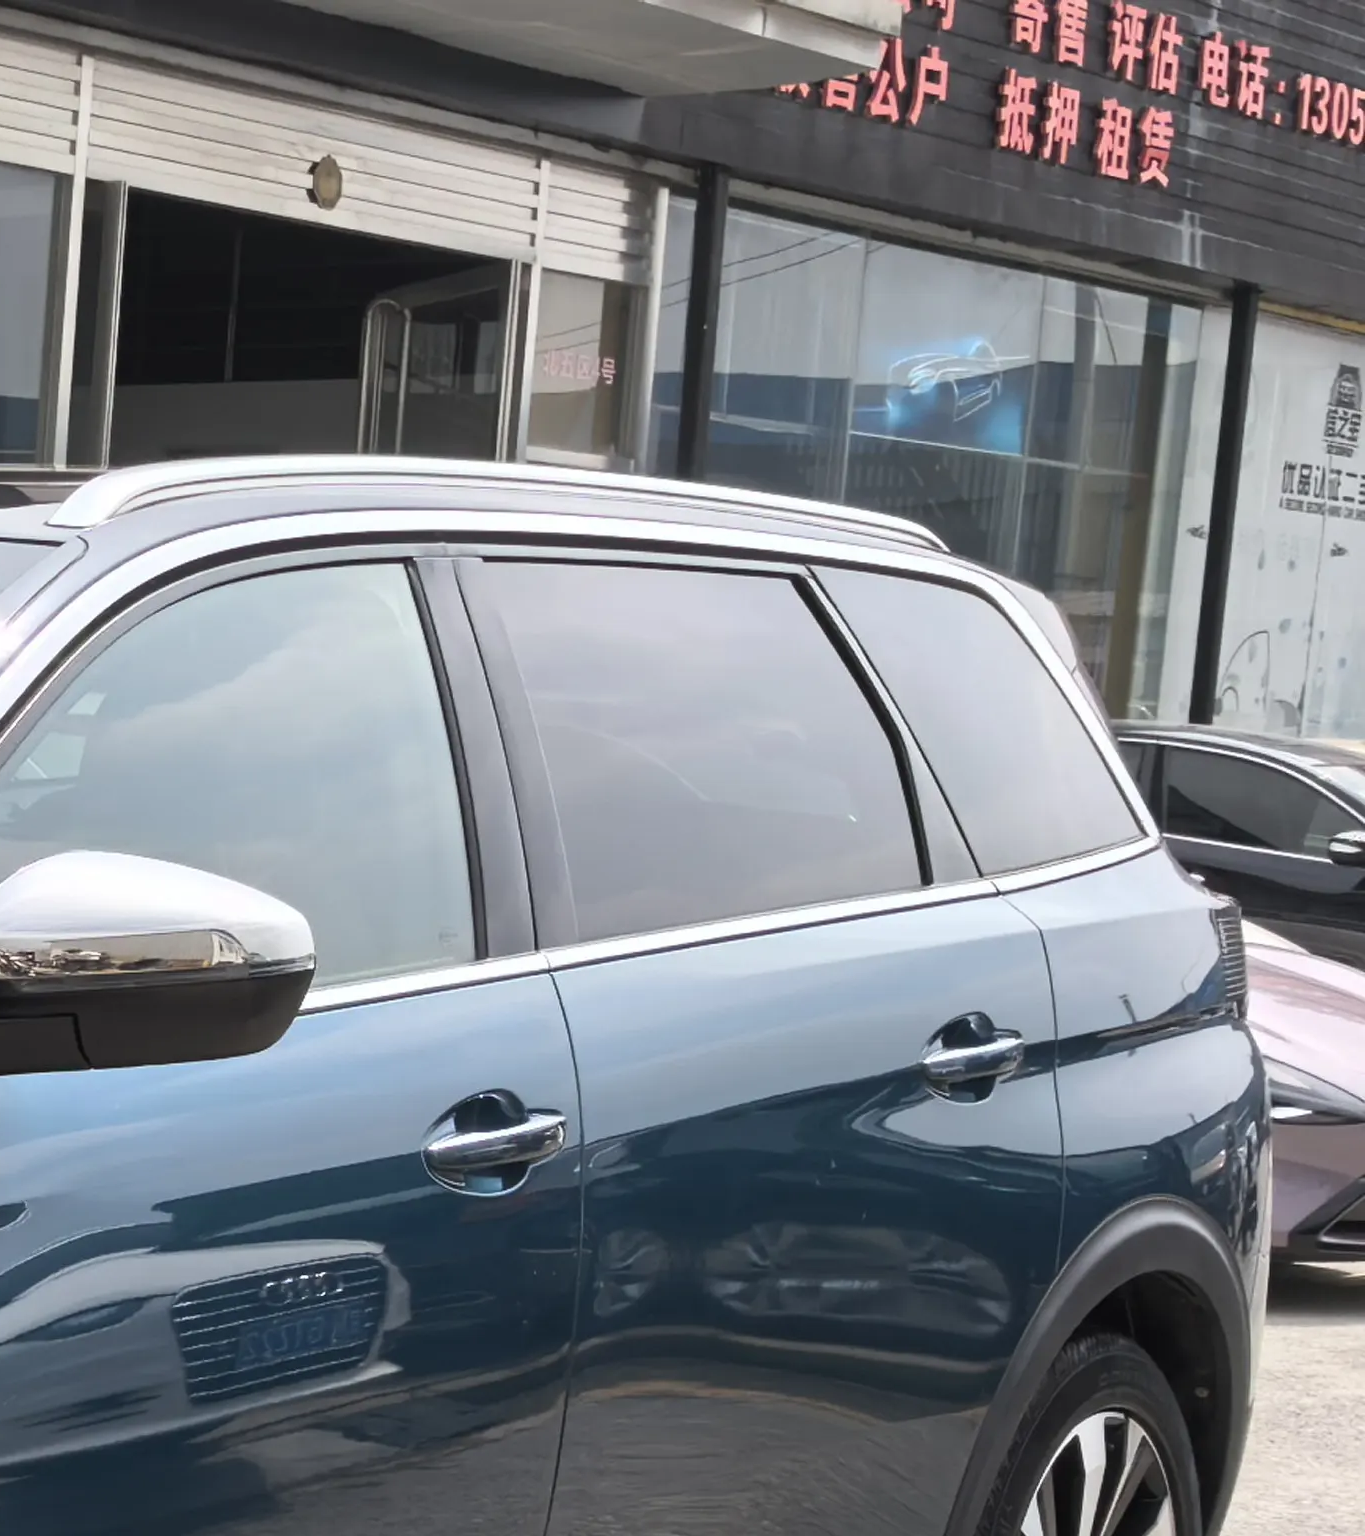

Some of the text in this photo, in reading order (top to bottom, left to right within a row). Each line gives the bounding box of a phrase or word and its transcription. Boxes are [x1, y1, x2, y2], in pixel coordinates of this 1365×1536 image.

[1109, 0, 1184, 95] 评估
[998, 66, 1081, 165] 抵押
[1096, 96, 1175, 188] 租赁
